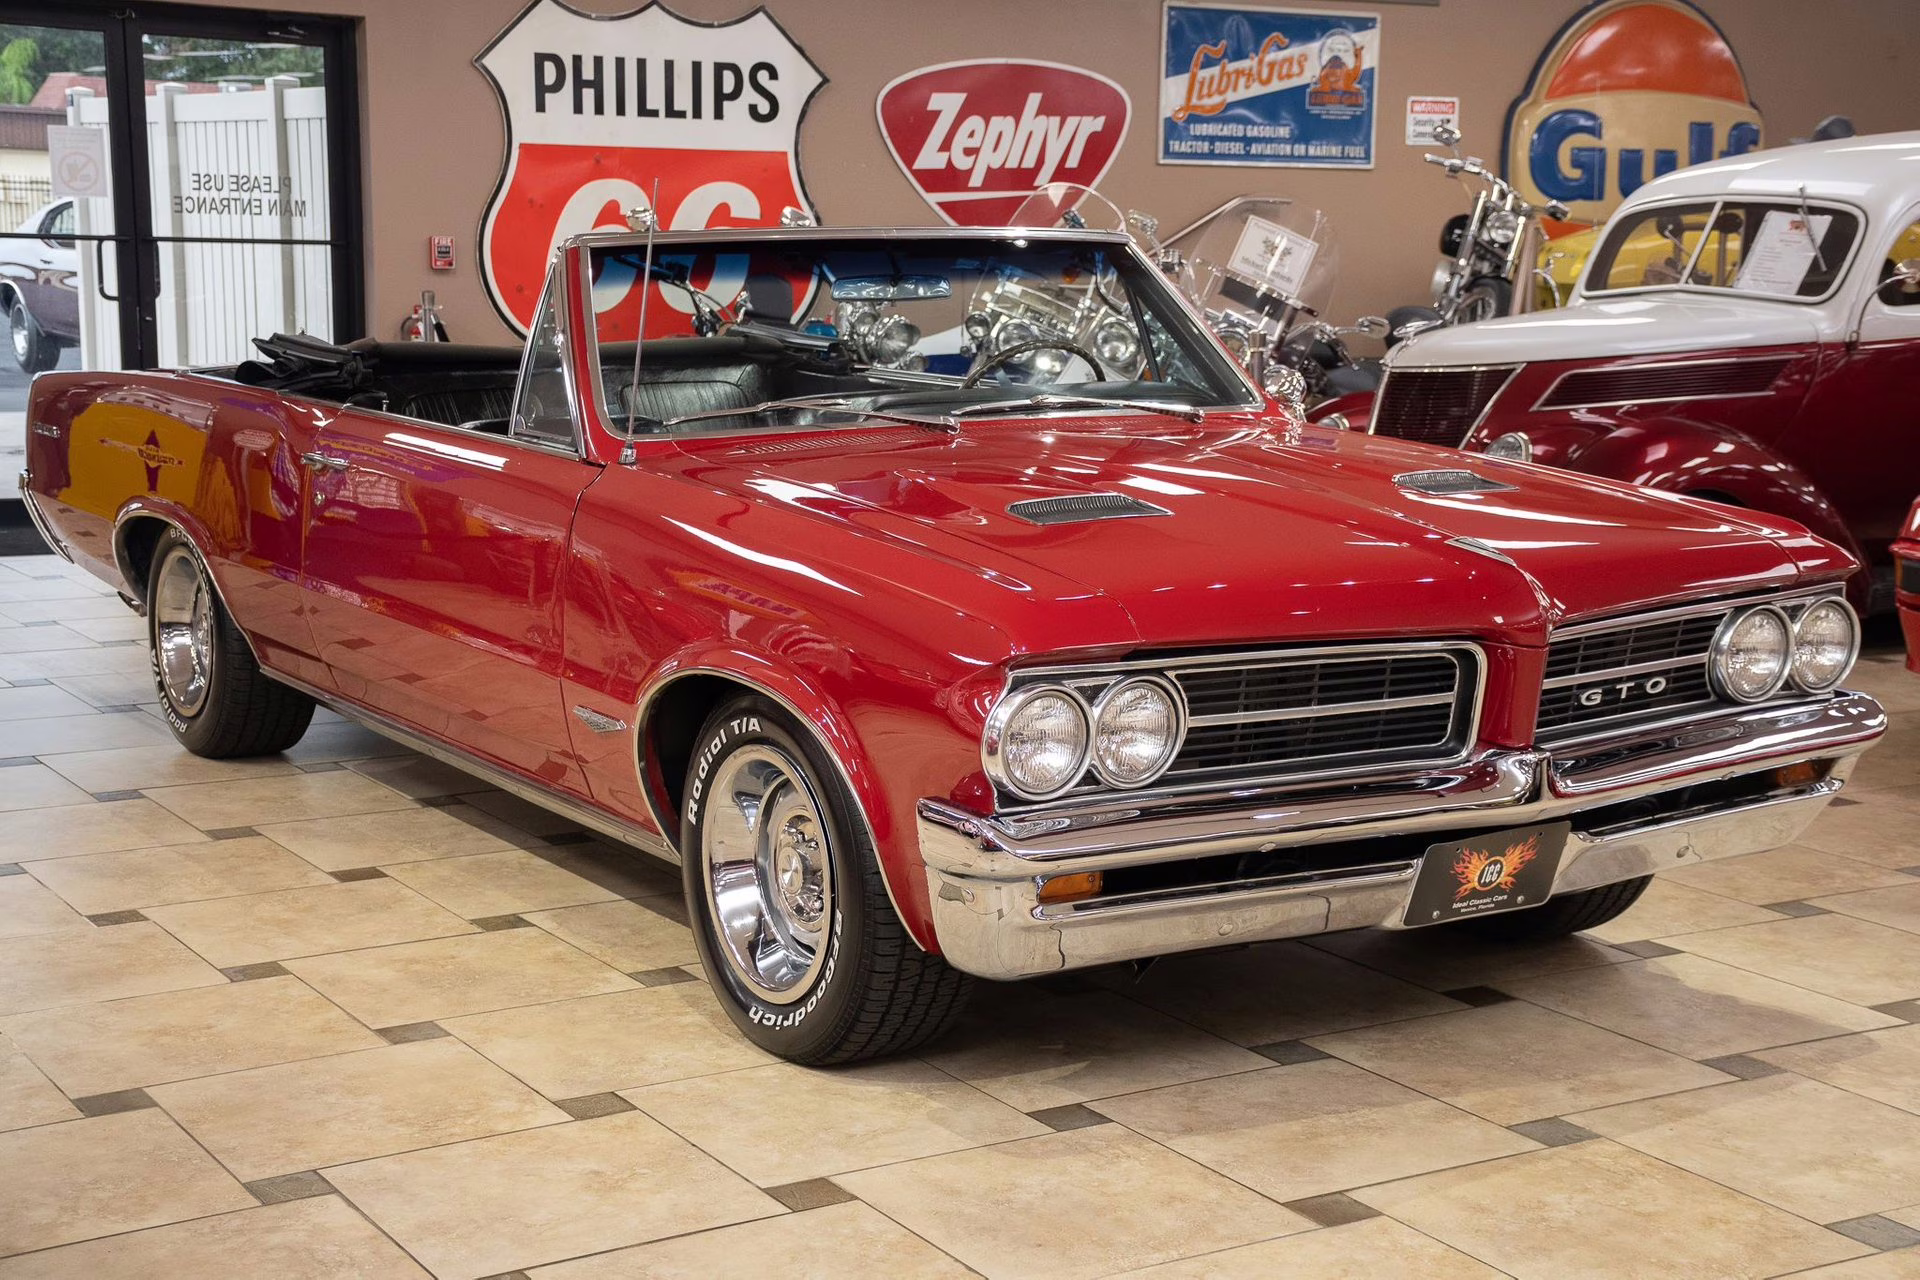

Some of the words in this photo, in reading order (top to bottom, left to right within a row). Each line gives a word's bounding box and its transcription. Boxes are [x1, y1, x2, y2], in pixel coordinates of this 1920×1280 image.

[534, 52, 780, 123] PHILLIPS
[912, 92, 1106, 188] Zephyr
[1168, 140, 1210, 153] TRACTOR
[1214, 141, 1246, 154] DIESEL
[1249, 142, 1293, 156] AVIATION
[1293, 143, 1304, 156] OR
[1307, 144, 1343, 157] MARINE
[1344, 145, 1365, 158] FUEL
[1189, 123, 1244, 137] LUBRICATED
[1246, 125, 1291, 138] GASOLINE
[545, 178, 762, 315] 66
[1580, 676, 1667, 706] GTO
[688, 728, 728, 826] Radial
[730, 717, 762, 735] T/A
[1452, 901, 1469, 909] Ideal
[1469, 897, 1492, 906] Classic
[748, 908, 843, 1031] BFGoodrich
